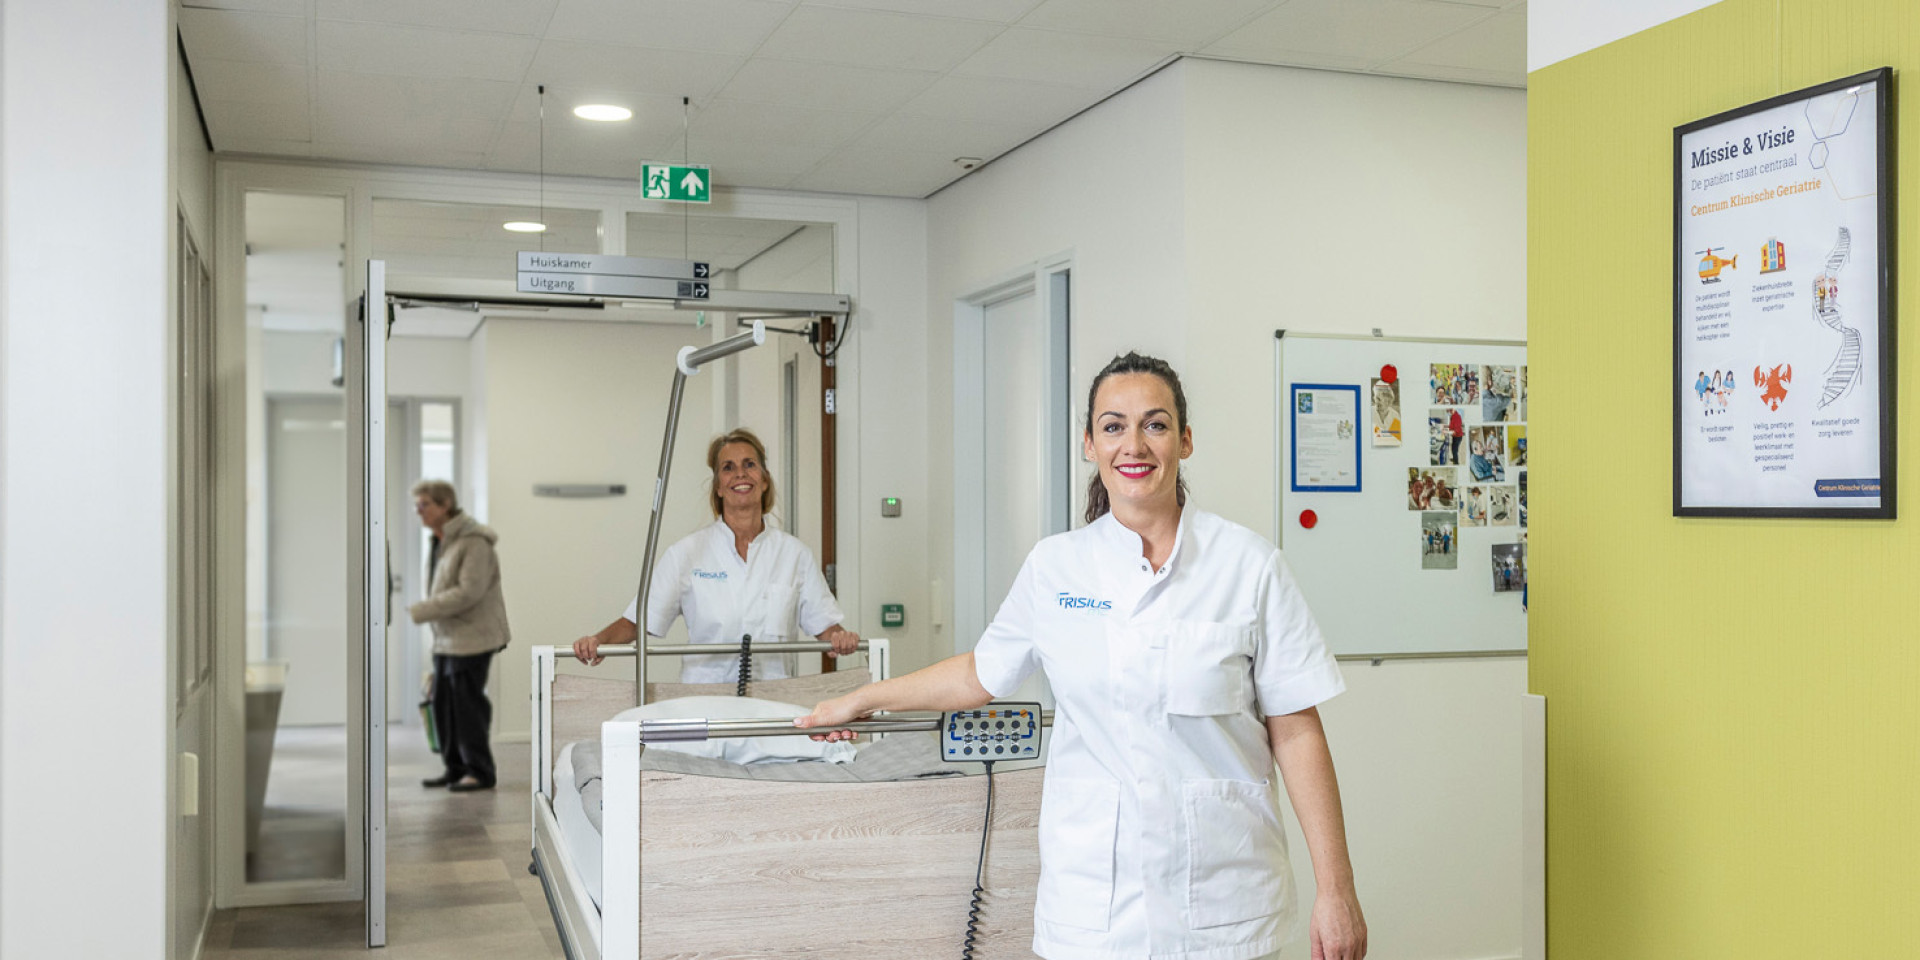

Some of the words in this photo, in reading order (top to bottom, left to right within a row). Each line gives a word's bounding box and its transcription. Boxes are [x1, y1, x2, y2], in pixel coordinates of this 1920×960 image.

[1691, 141, 1738, 169] Missie
[1742, 137, 1753, 155] &
[1757, 126, 1795, 151] Visie
[1691, 179, 1702, 191] De
[1704, 172, 1734, 191] patiënt
[1736, 165, 1757, 180] staat
[1759, 153, 1797, 174] centraal
[1691, 200, 1729, 217] Centrum
[1730, 188, 1775, 208] Klinische
[1776, 178, 1822, 197] Geriatrie
[530, 256, 592, 269] Huiskamer
[530, 277, 575, 291] Uitgang
[1056, 592, 1112, 609] FRISIUS
